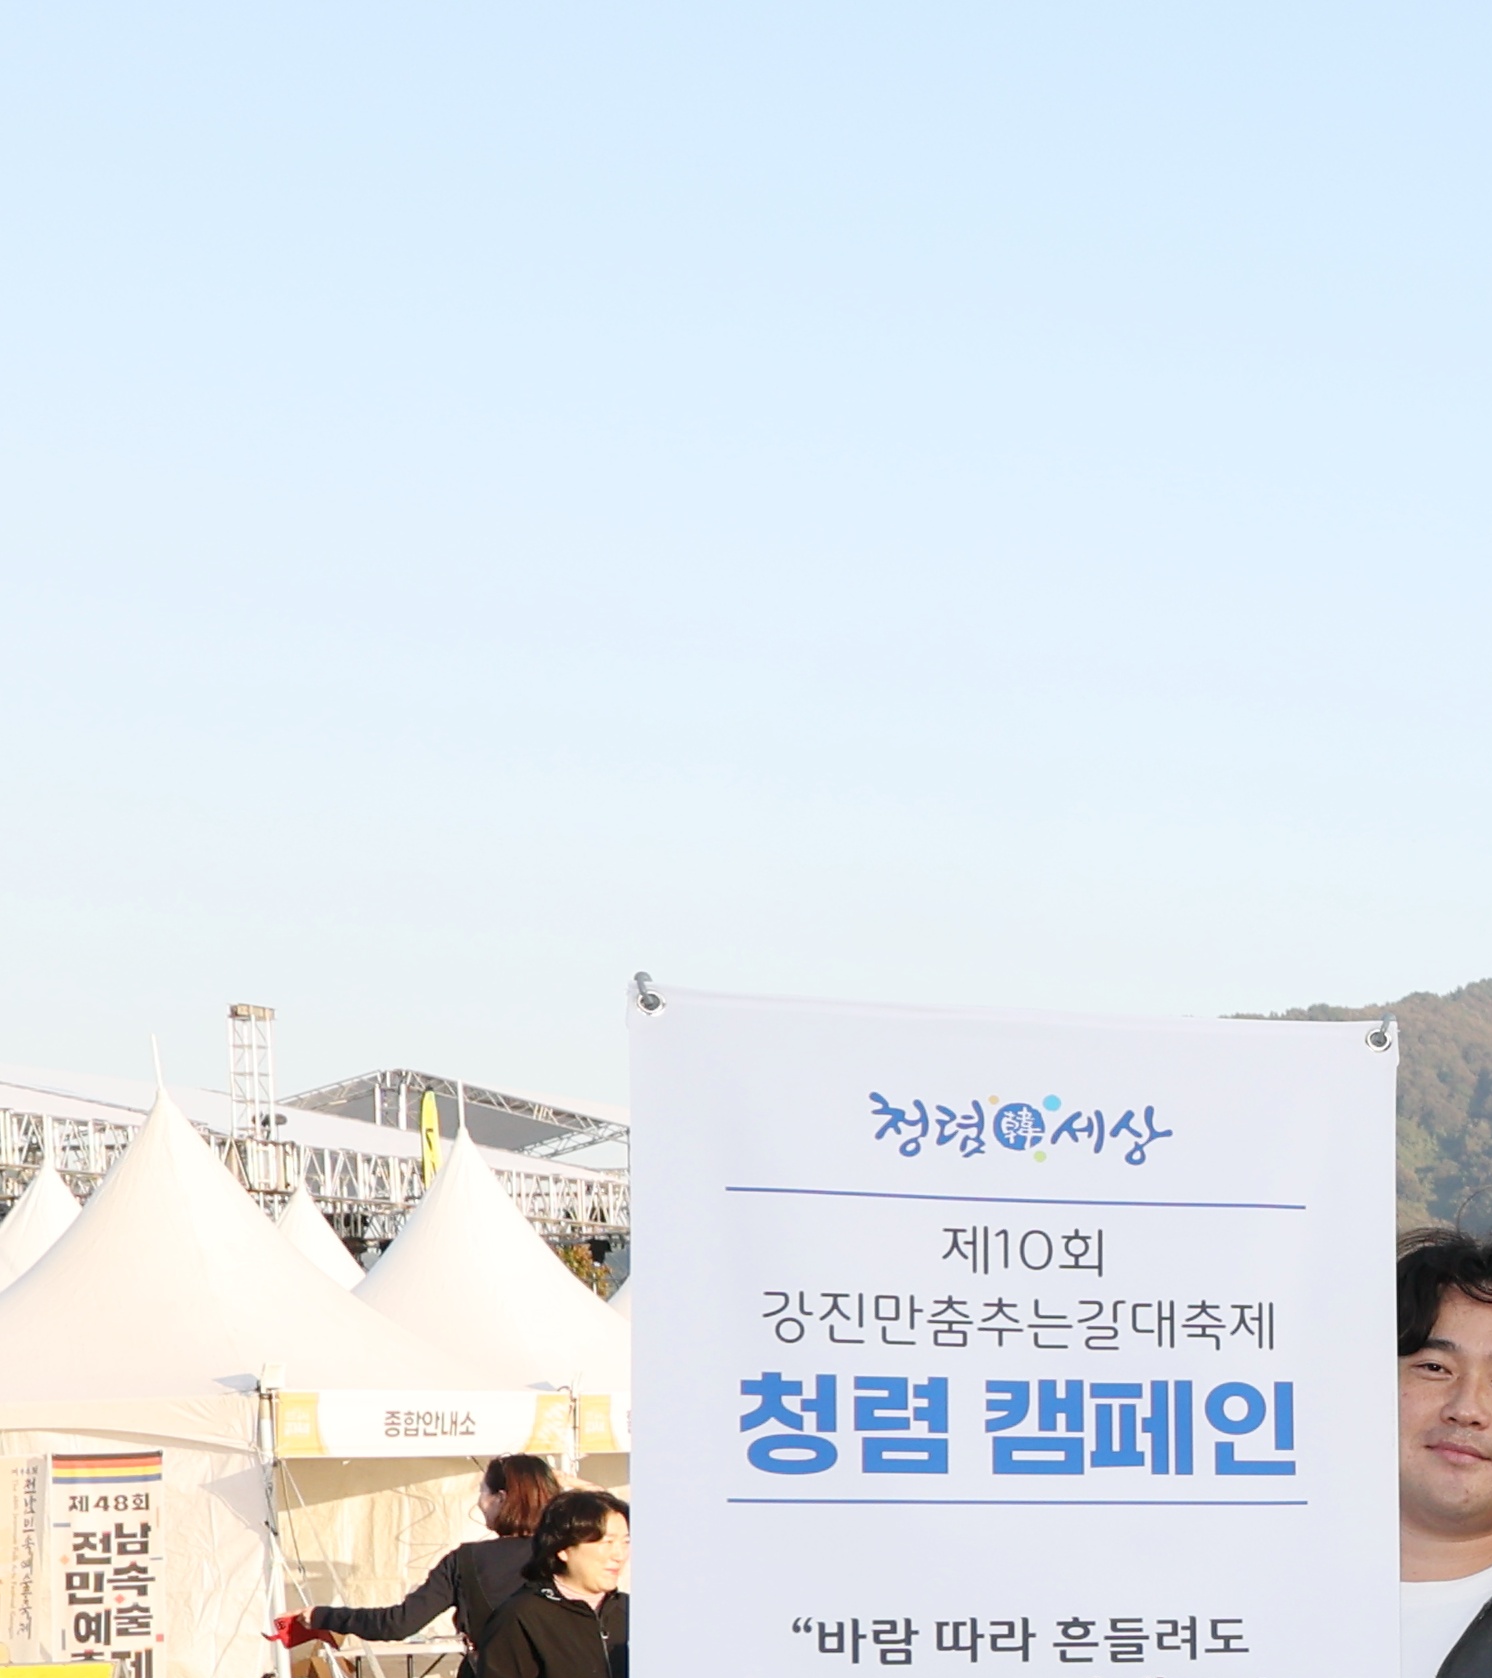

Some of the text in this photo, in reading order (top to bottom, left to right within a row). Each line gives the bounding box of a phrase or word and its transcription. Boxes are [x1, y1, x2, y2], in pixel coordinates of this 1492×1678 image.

[941, 1225, 1105, 1278] 제10회
[762, 1289, 1276, 1352] 강진만춤추는갈대축제
[384, 1410, 476, 1437] 종합안내소
[739, 1371, 1297, 1476] 청렴 캠페인
[68, 1493, 150, 1512] 제48회
[72, 1522, 152, 1565] 전남
[65, 1561, 156, 1605] 민속
[73, 1602, 154, 1645] 예술
[935, 1617, 1035, 1663] 따라
[1053, 1615, 1250, 1664] 흔들려도
